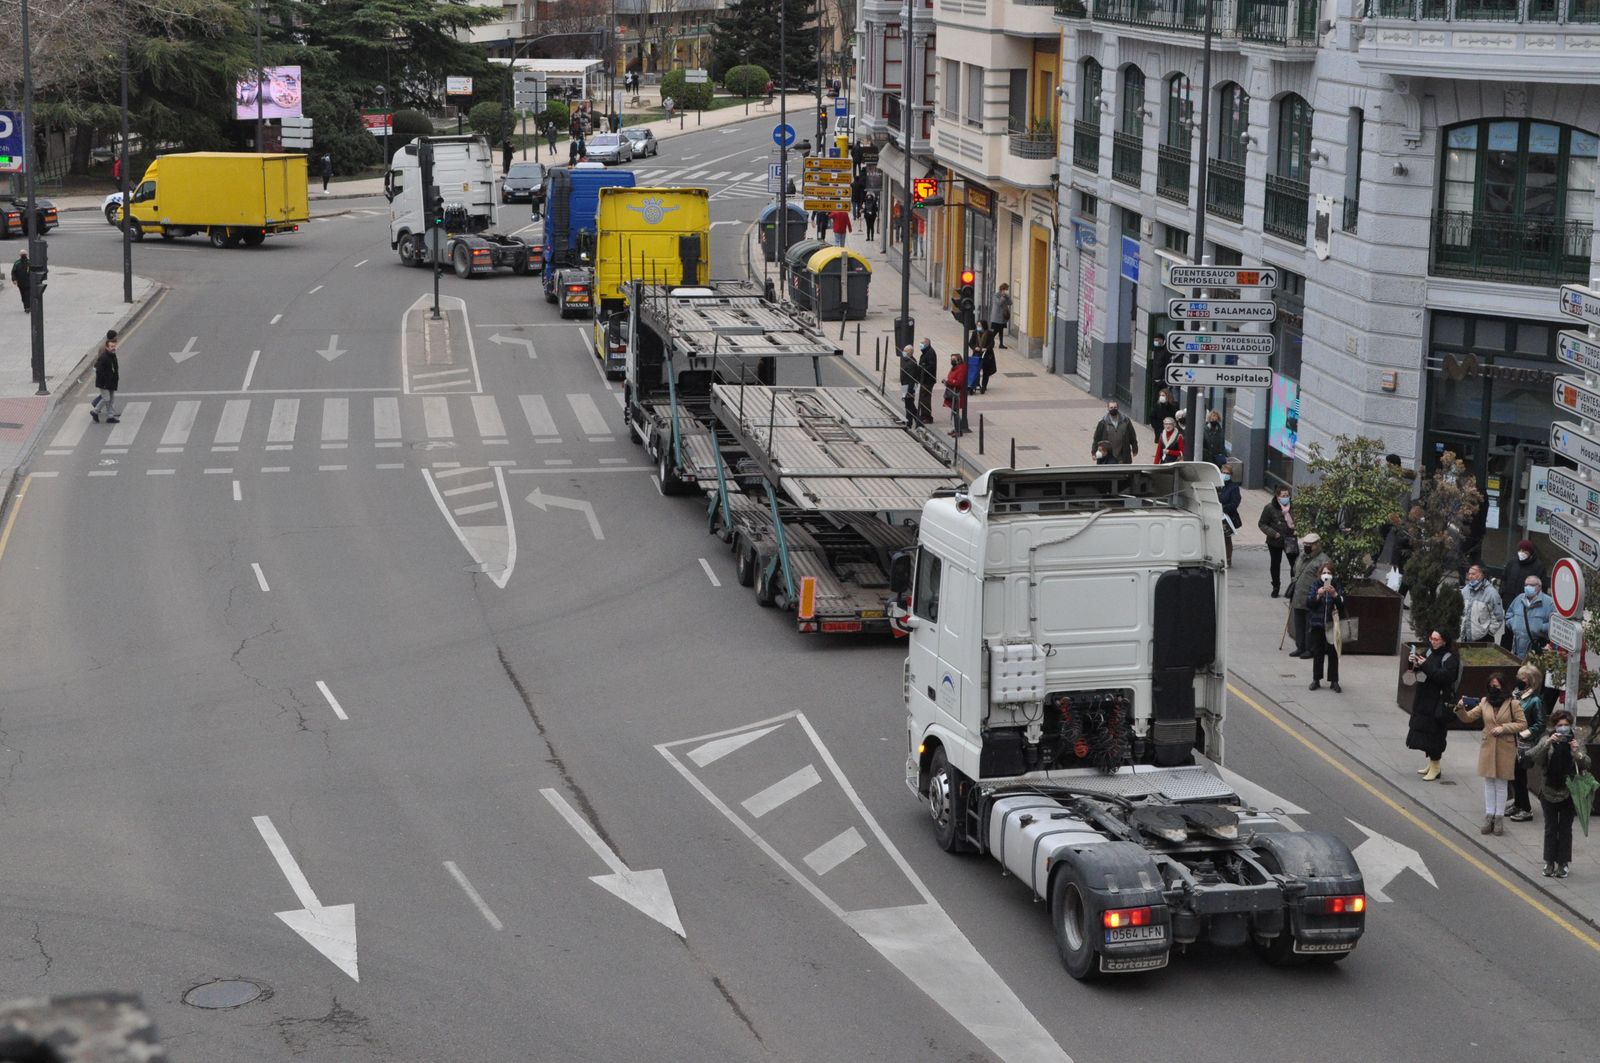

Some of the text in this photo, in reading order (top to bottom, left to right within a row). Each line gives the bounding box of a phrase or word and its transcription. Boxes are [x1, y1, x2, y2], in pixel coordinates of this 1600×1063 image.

[1214, 307, 1272, 315] SALAMANCA
[1216, 373, 1269, 383] Hospitales
[1112, 926, 1162, 940] 0564 LFN
[1108, 959, 1163, 969] cortazar
